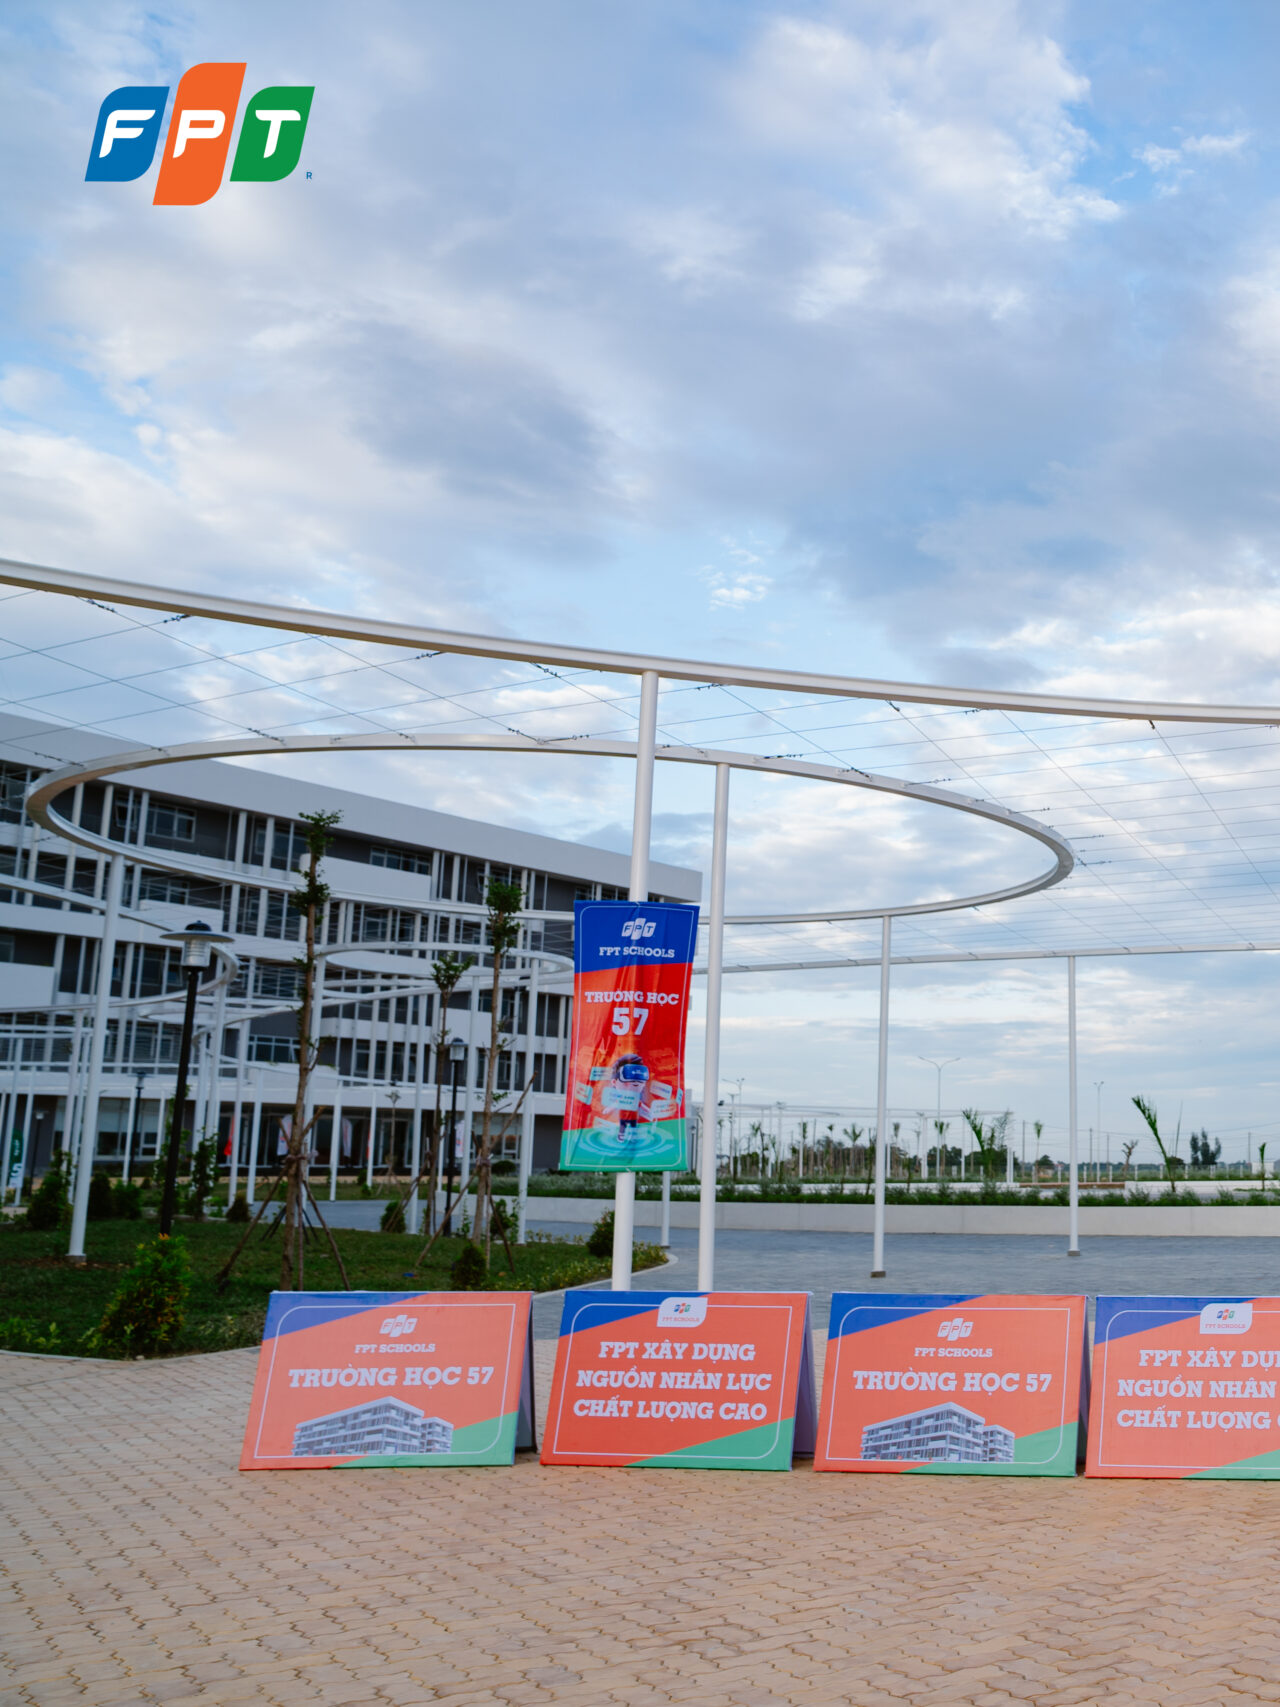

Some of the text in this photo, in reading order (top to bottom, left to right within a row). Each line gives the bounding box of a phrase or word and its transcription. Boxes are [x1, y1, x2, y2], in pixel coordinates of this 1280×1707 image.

[599, 946, 675, 958] FPT SCHOOLS
[647, 992, 679, 1006] HỌC
[612, 1008, 649, 1035] 57
[354, 1343, 435, 1353] FPT SCHOOLS
[599, 1341, 639, 1358] FPT
[642, 1339, 688, 1360] XÂY
[914, 1347, 992, 1358] FPT SCHOOLS
[1139, 1350, 1182, 1367] FPT
[1186, 1347, 1236, 1367] XÂY
[289, 1364, 494, 1389] TRƯỜNG HỌC 57
[576, 1366, 772, 1394] NGUỒN NHÂN LỰC
[853, 1367, 1052, 1396] TRƯỜNG HỌC 57
[1117, 1375, 1203, 1397] NGUỒN
[1209, 1378, 1276, 1398] NHÂN
[573, 1395, 767, 1422] CHẤT LƯỢNG CAO
[1117, 1406, 1181, 1428] CHẤT
[1186, 1410, 1271, 1432] LƯỢNG
